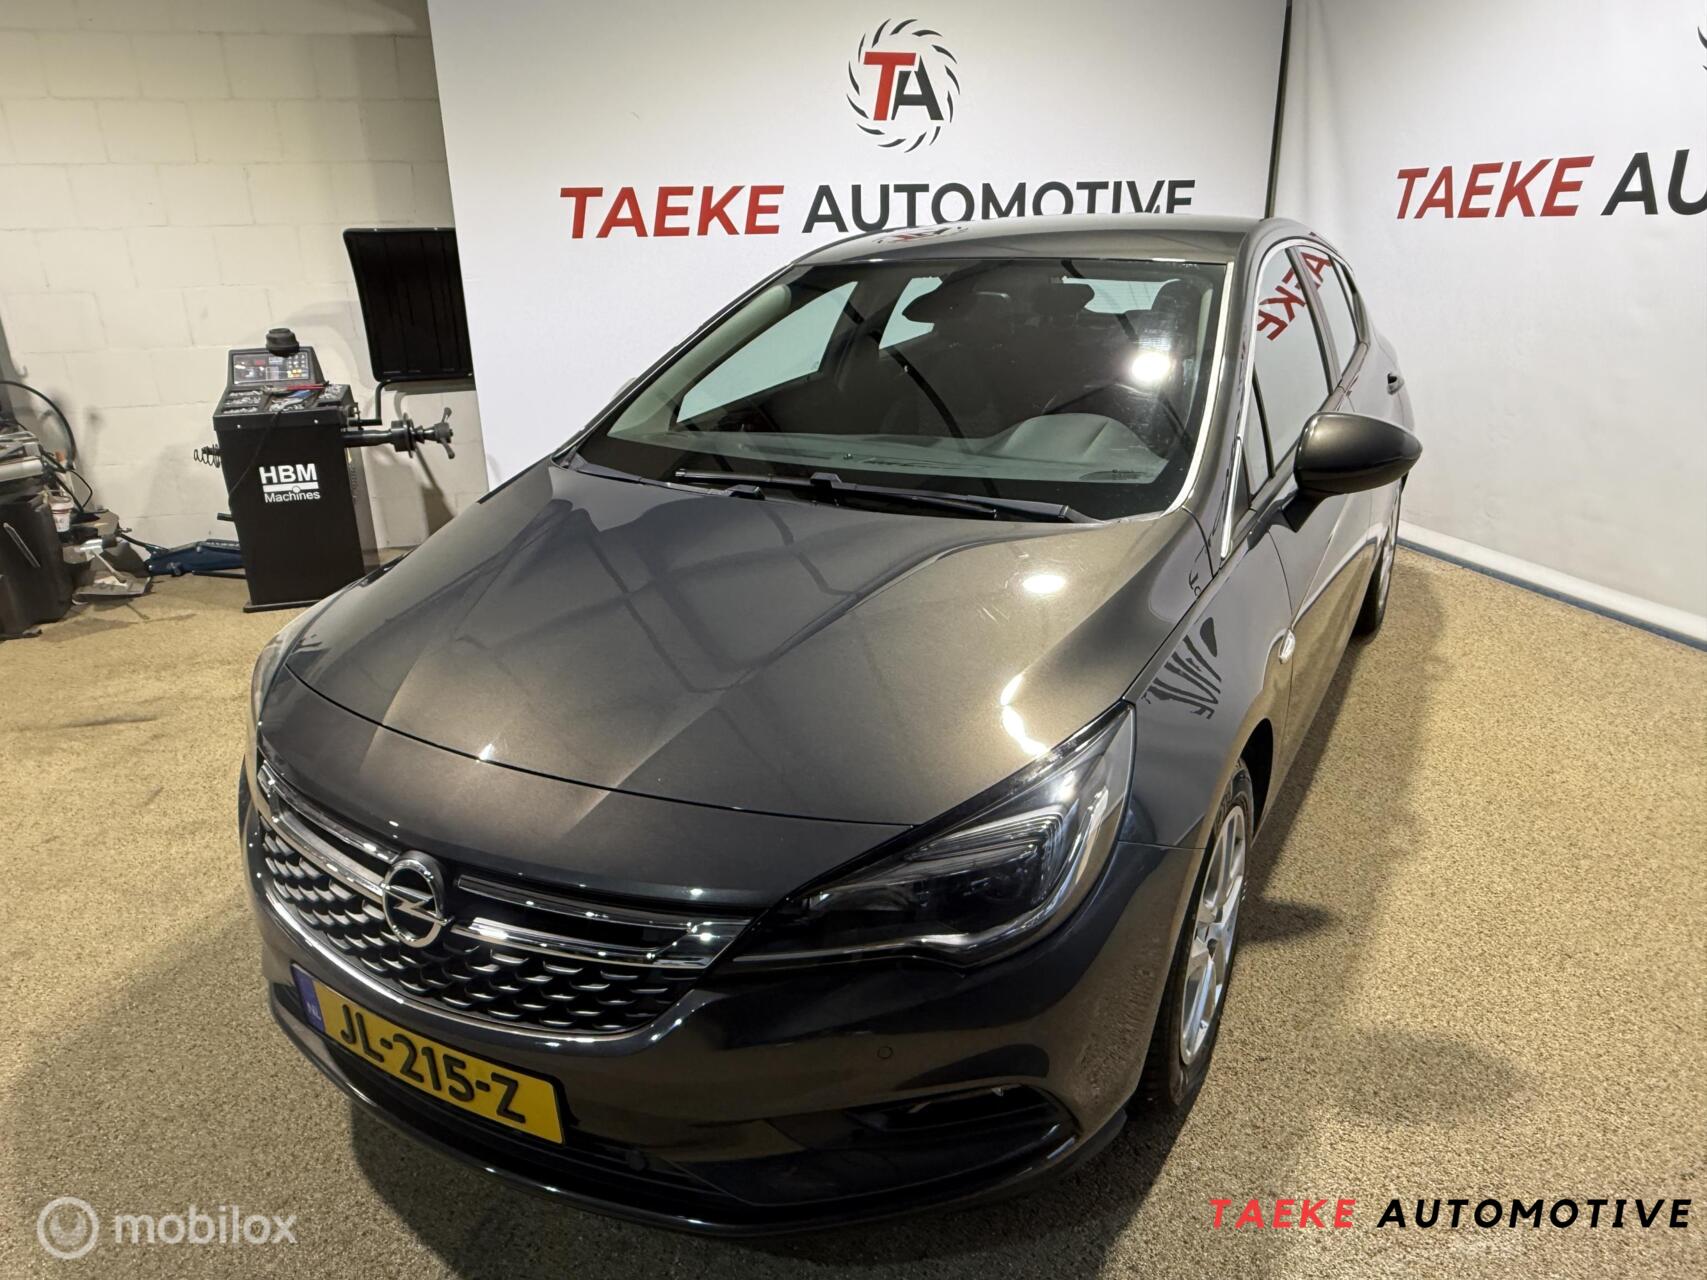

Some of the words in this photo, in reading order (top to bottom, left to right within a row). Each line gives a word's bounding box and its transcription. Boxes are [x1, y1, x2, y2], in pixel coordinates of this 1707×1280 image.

[863, 51, 944, 122] TA
[560, 184, 784, 239] TAEKE
[801, 179, 1196, 233] AUTOMOTIVE
[1397, 155, 1595, 219] TAEKE
[259, 463, 318, 484] HBM
[264, 491, 321, 503] Machines
[340, 1004, 526, 1124] JL-215-Z
